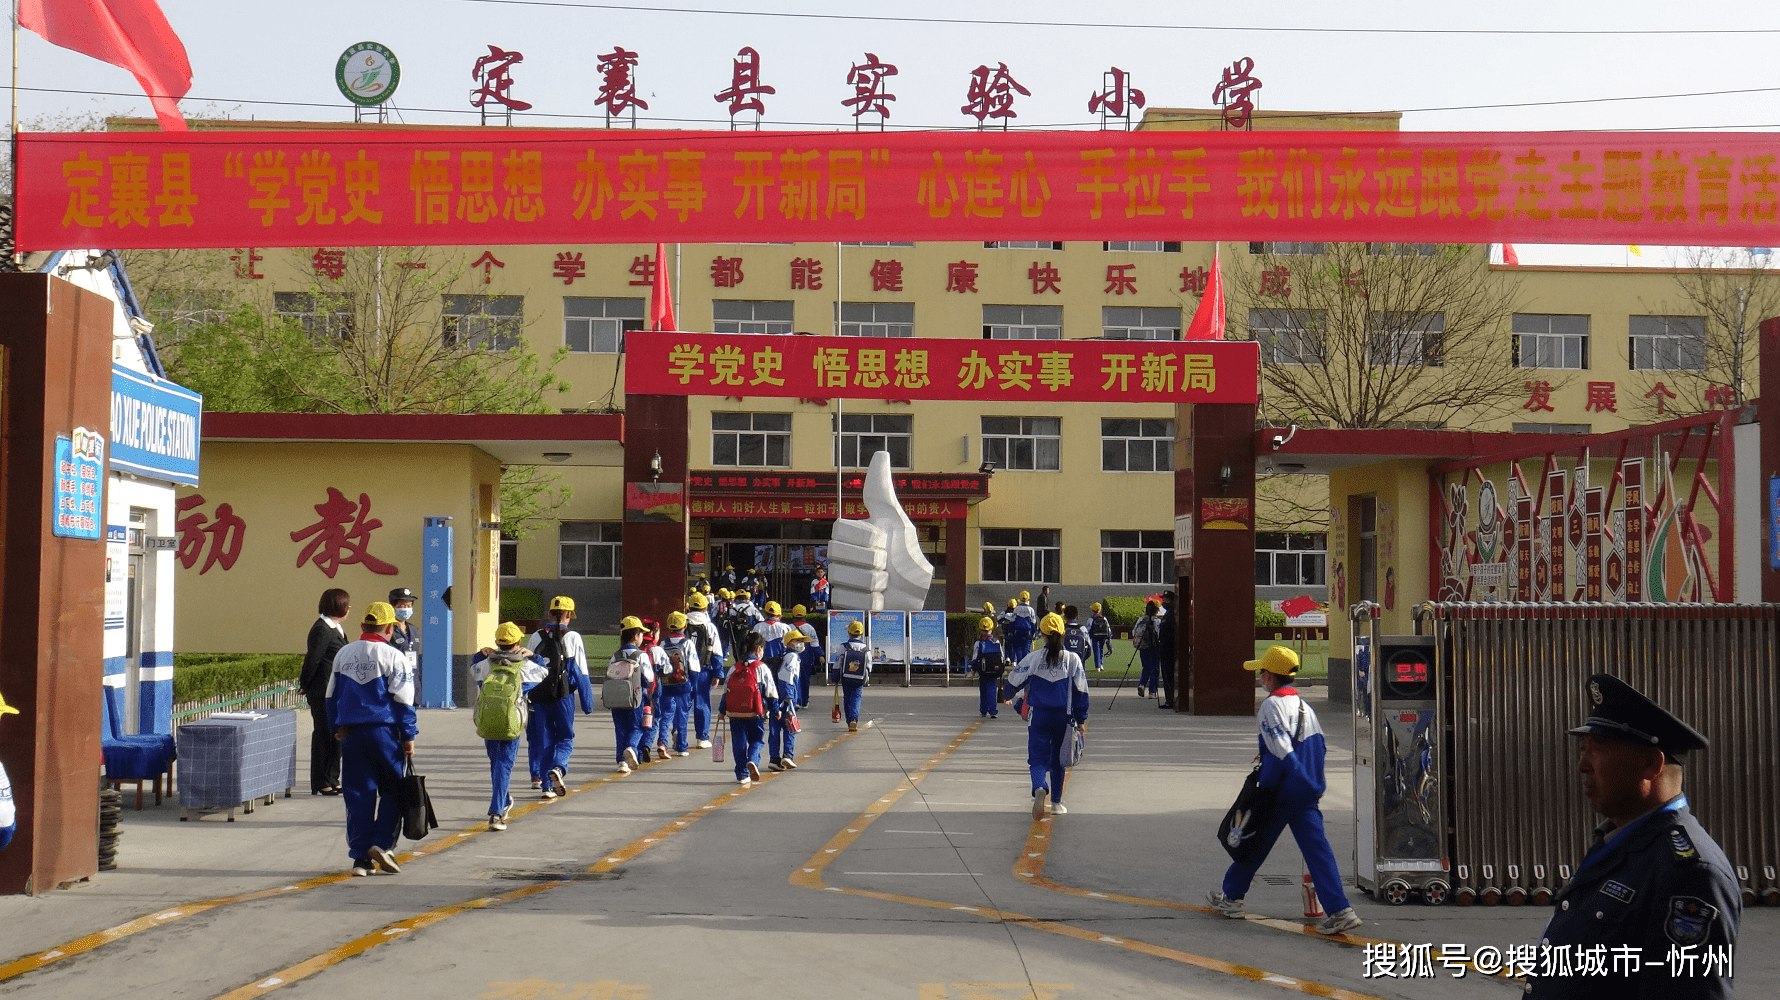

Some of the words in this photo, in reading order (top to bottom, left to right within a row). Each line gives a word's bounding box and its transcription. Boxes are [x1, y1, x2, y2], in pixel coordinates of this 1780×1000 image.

[471, 45, 1262, 128] 定襄县实验小学
[61, 151, 198, 229] 定襄县
[410, 148, 546, 225] 悟思想
[571, 147, 706, 223] 办实事
[917, 150, 1051, 219] 心连心
[1077, 147, 1210, 220] 手拉手
[668, 343, 786, 387] 学党史
[813, 347, 931, 390] 悟思想
[957, 350, 1075, 392] 办实事
[1101, 353, 1217, 394] 开新局
[122, 395, 140, 448] XUE
[140, 401, 167, 455] POLICE
[167, 409, 195, 461] STATION
[732, 502, 839, 514] 扣好人生第一粒扣子
[146, 538, 177, 548] 门卫室
